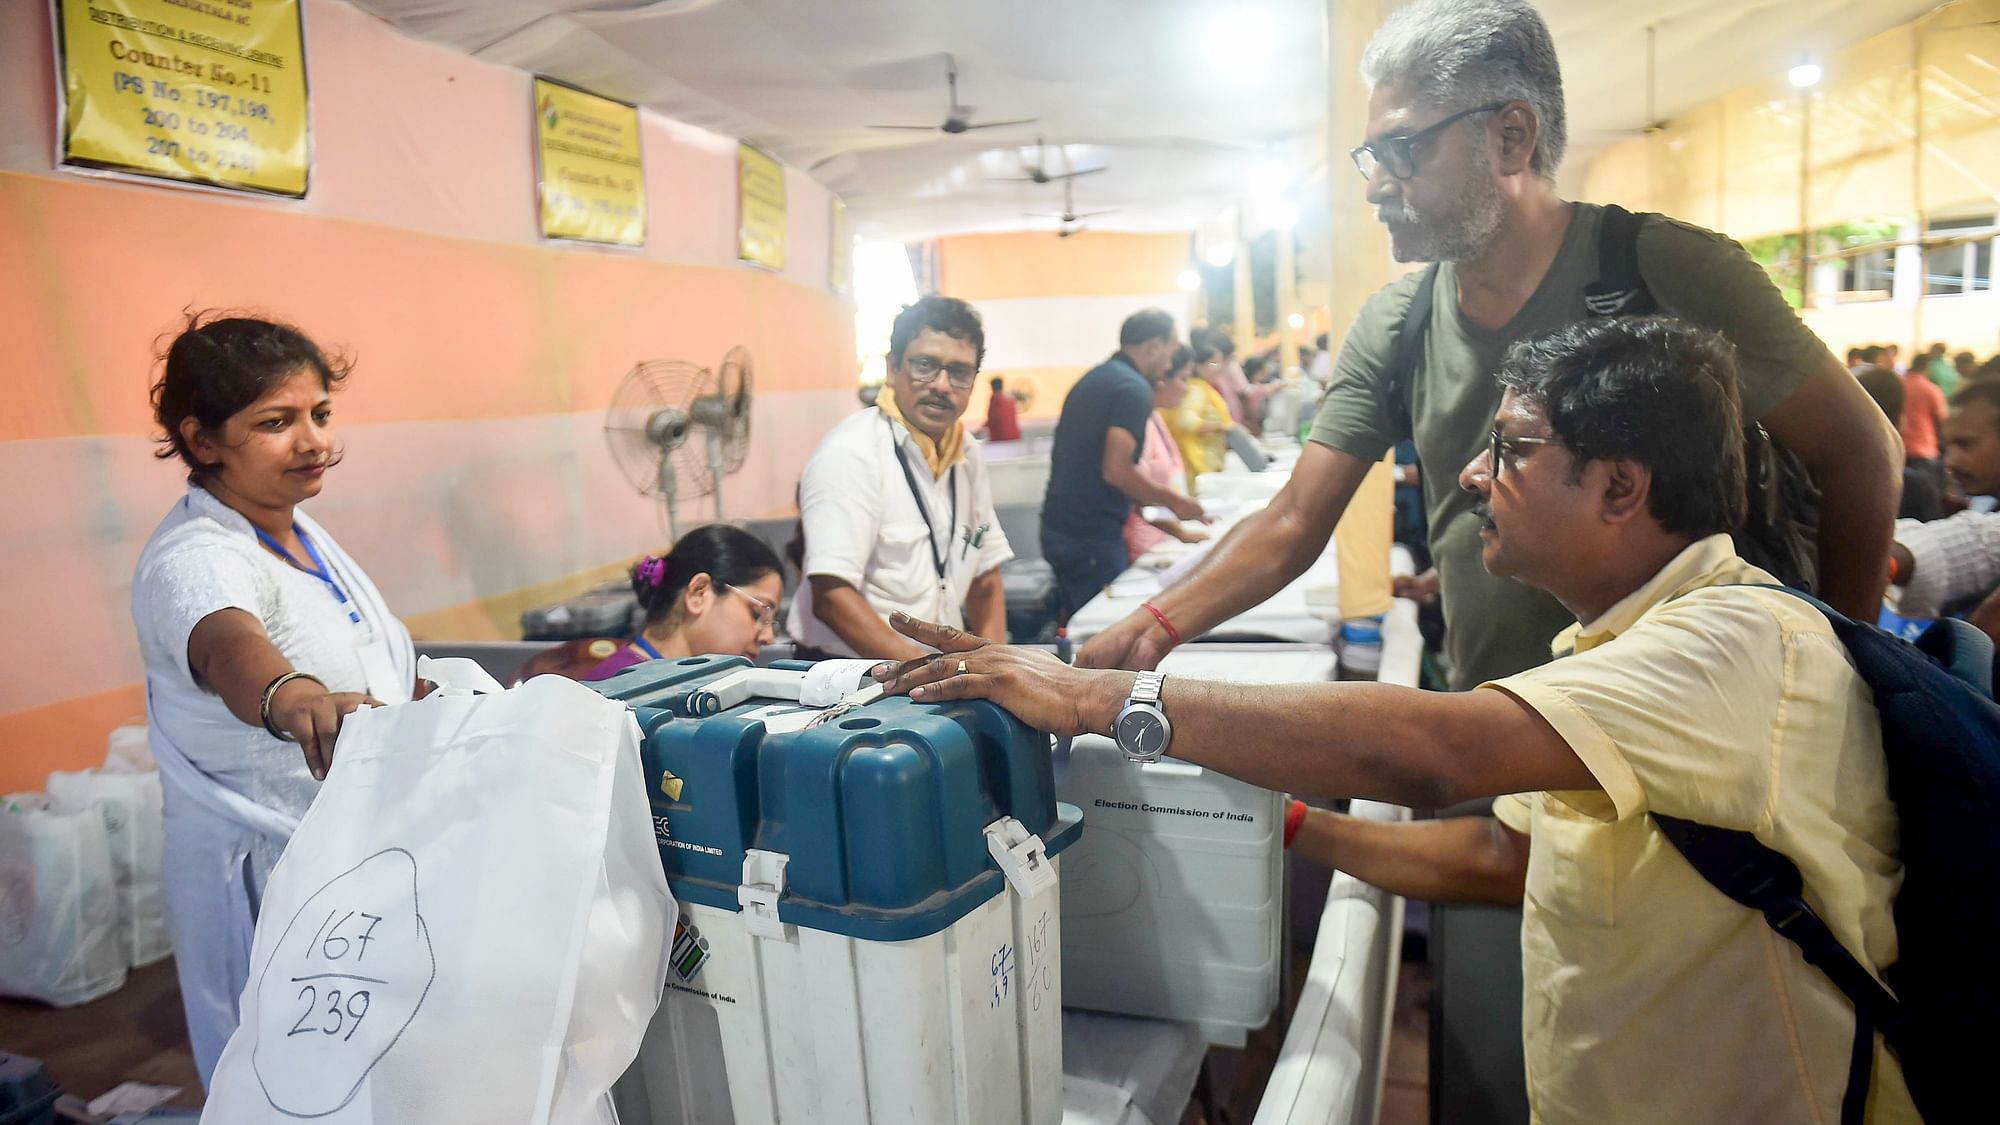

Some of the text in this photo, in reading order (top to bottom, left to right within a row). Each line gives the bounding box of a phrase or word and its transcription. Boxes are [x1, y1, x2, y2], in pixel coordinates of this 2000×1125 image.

[88, 6, 176, 37] DISTRIBUTION
[249, 49, 284, 65] CENTRE
[109, 39, 272, 94] Counter No.-11
[113, 71, 145, 95] (PS
[152, 80, 185, 102] No.
[141, 106, 180, 130] 200
[187, 115, 208, 136] to
[145, 137, 180, 158] 207
[187, 145, 208, 165] to
[1094, 799, 1254, 823] Election Commission of India
[685, 842, 692, 851] OF
[692, 843, 704, 854] INDIA
[704, 845, 723, 856] LIMITED
[306, 909, 383, 962] 167
[1027, 911, 1050, 966] 167
[672, 983, 709, 998] Commission
[711, 992, 717, 1000] of
[719, 994, 736, 1004] India
[287, 985, 370, 1042] 239
